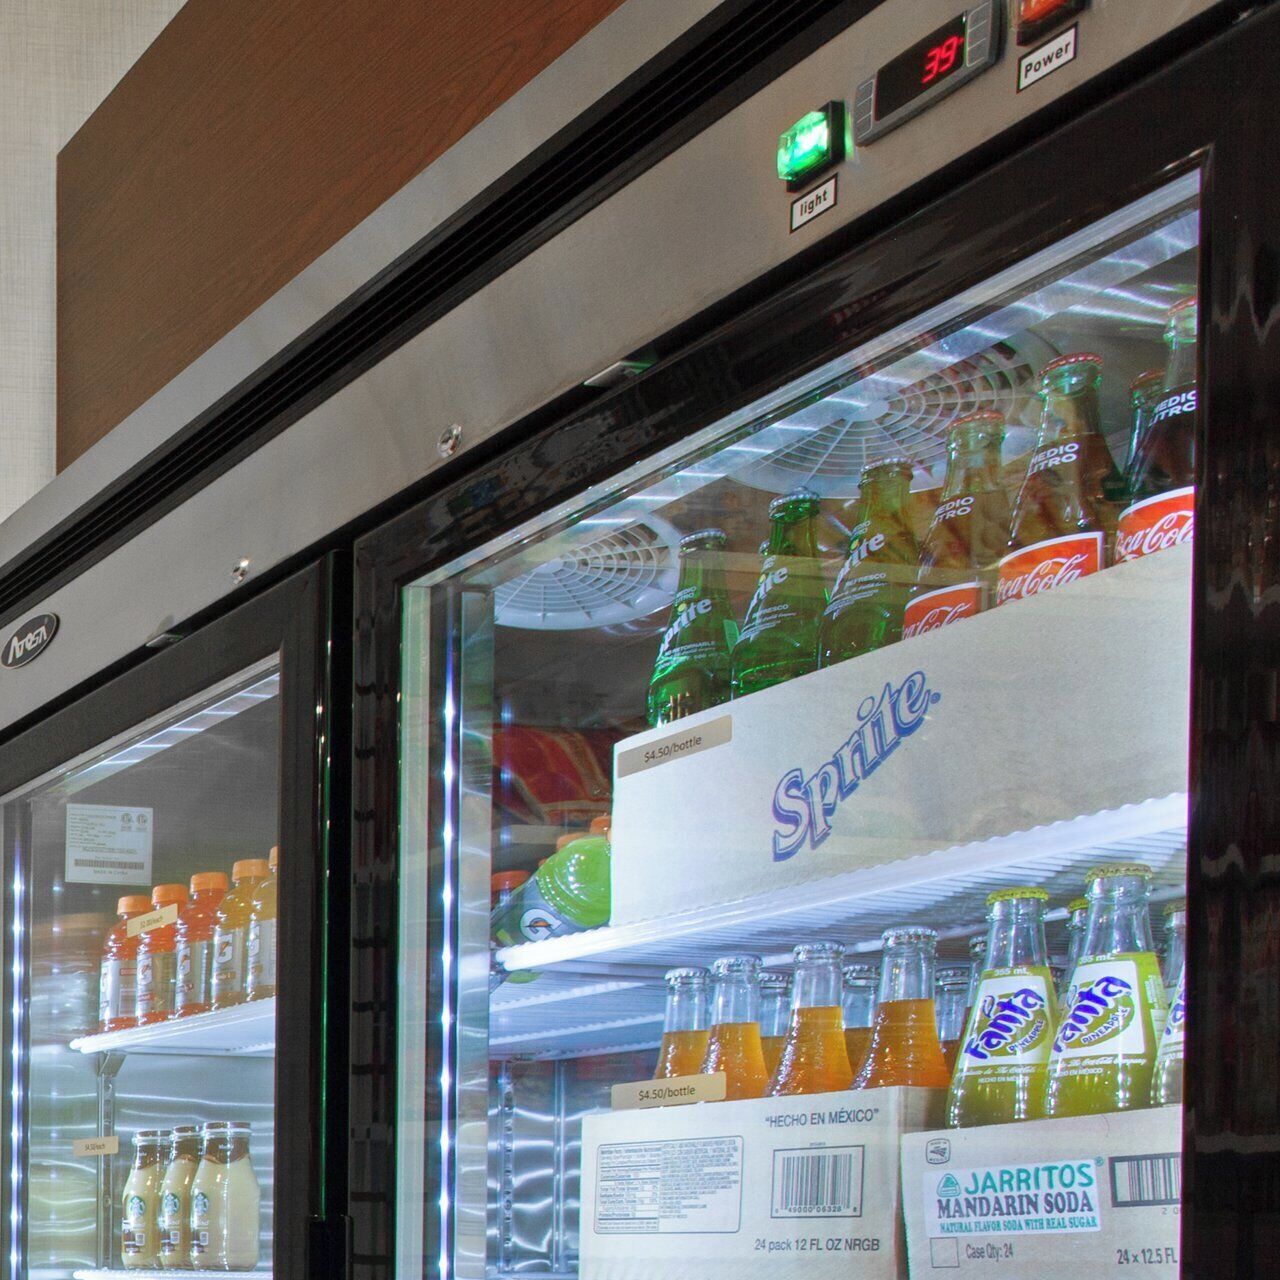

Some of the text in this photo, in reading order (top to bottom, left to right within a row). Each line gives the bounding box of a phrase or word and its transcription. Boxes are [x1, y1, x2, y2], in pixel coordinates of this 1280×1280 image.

[1024, 40, 1071, 79] Power
[800, 189, 829, 217] light
[643, 735, 702, 763] $4.50/bottle
[772, 670, 929, 863] Sprite
[964, 988, 1045, 1060] Fanta
[1052, 976, 1131, 1054] Fanta
[1082, 1006, 1130, 1045] PINEAPPLE
[1008, 1020, 1044, 1054] PINEAPPLE
[638, 1085, 696, 1101] $4.50/bottle
[811, 1112, 825, 1125] EN
[964, 1163, 1094, 1195] JARRITOS
[937, 1190, 1094, 1219] MANDARIN SODA
[940, 1216, 1098, 1234] NATURAL FLAVOR SODA WITH REAL SUGAR
[755, 1239, 880, 1253] 24 pack 12 FL OZ NRGB
[966, 1244, 984, 1259] Case
[1004, 1243, 1014, 1258] 24
[1116, 1249, 1129, 1265] 24
[1141, 1248, 1163, 1264] 12.5
